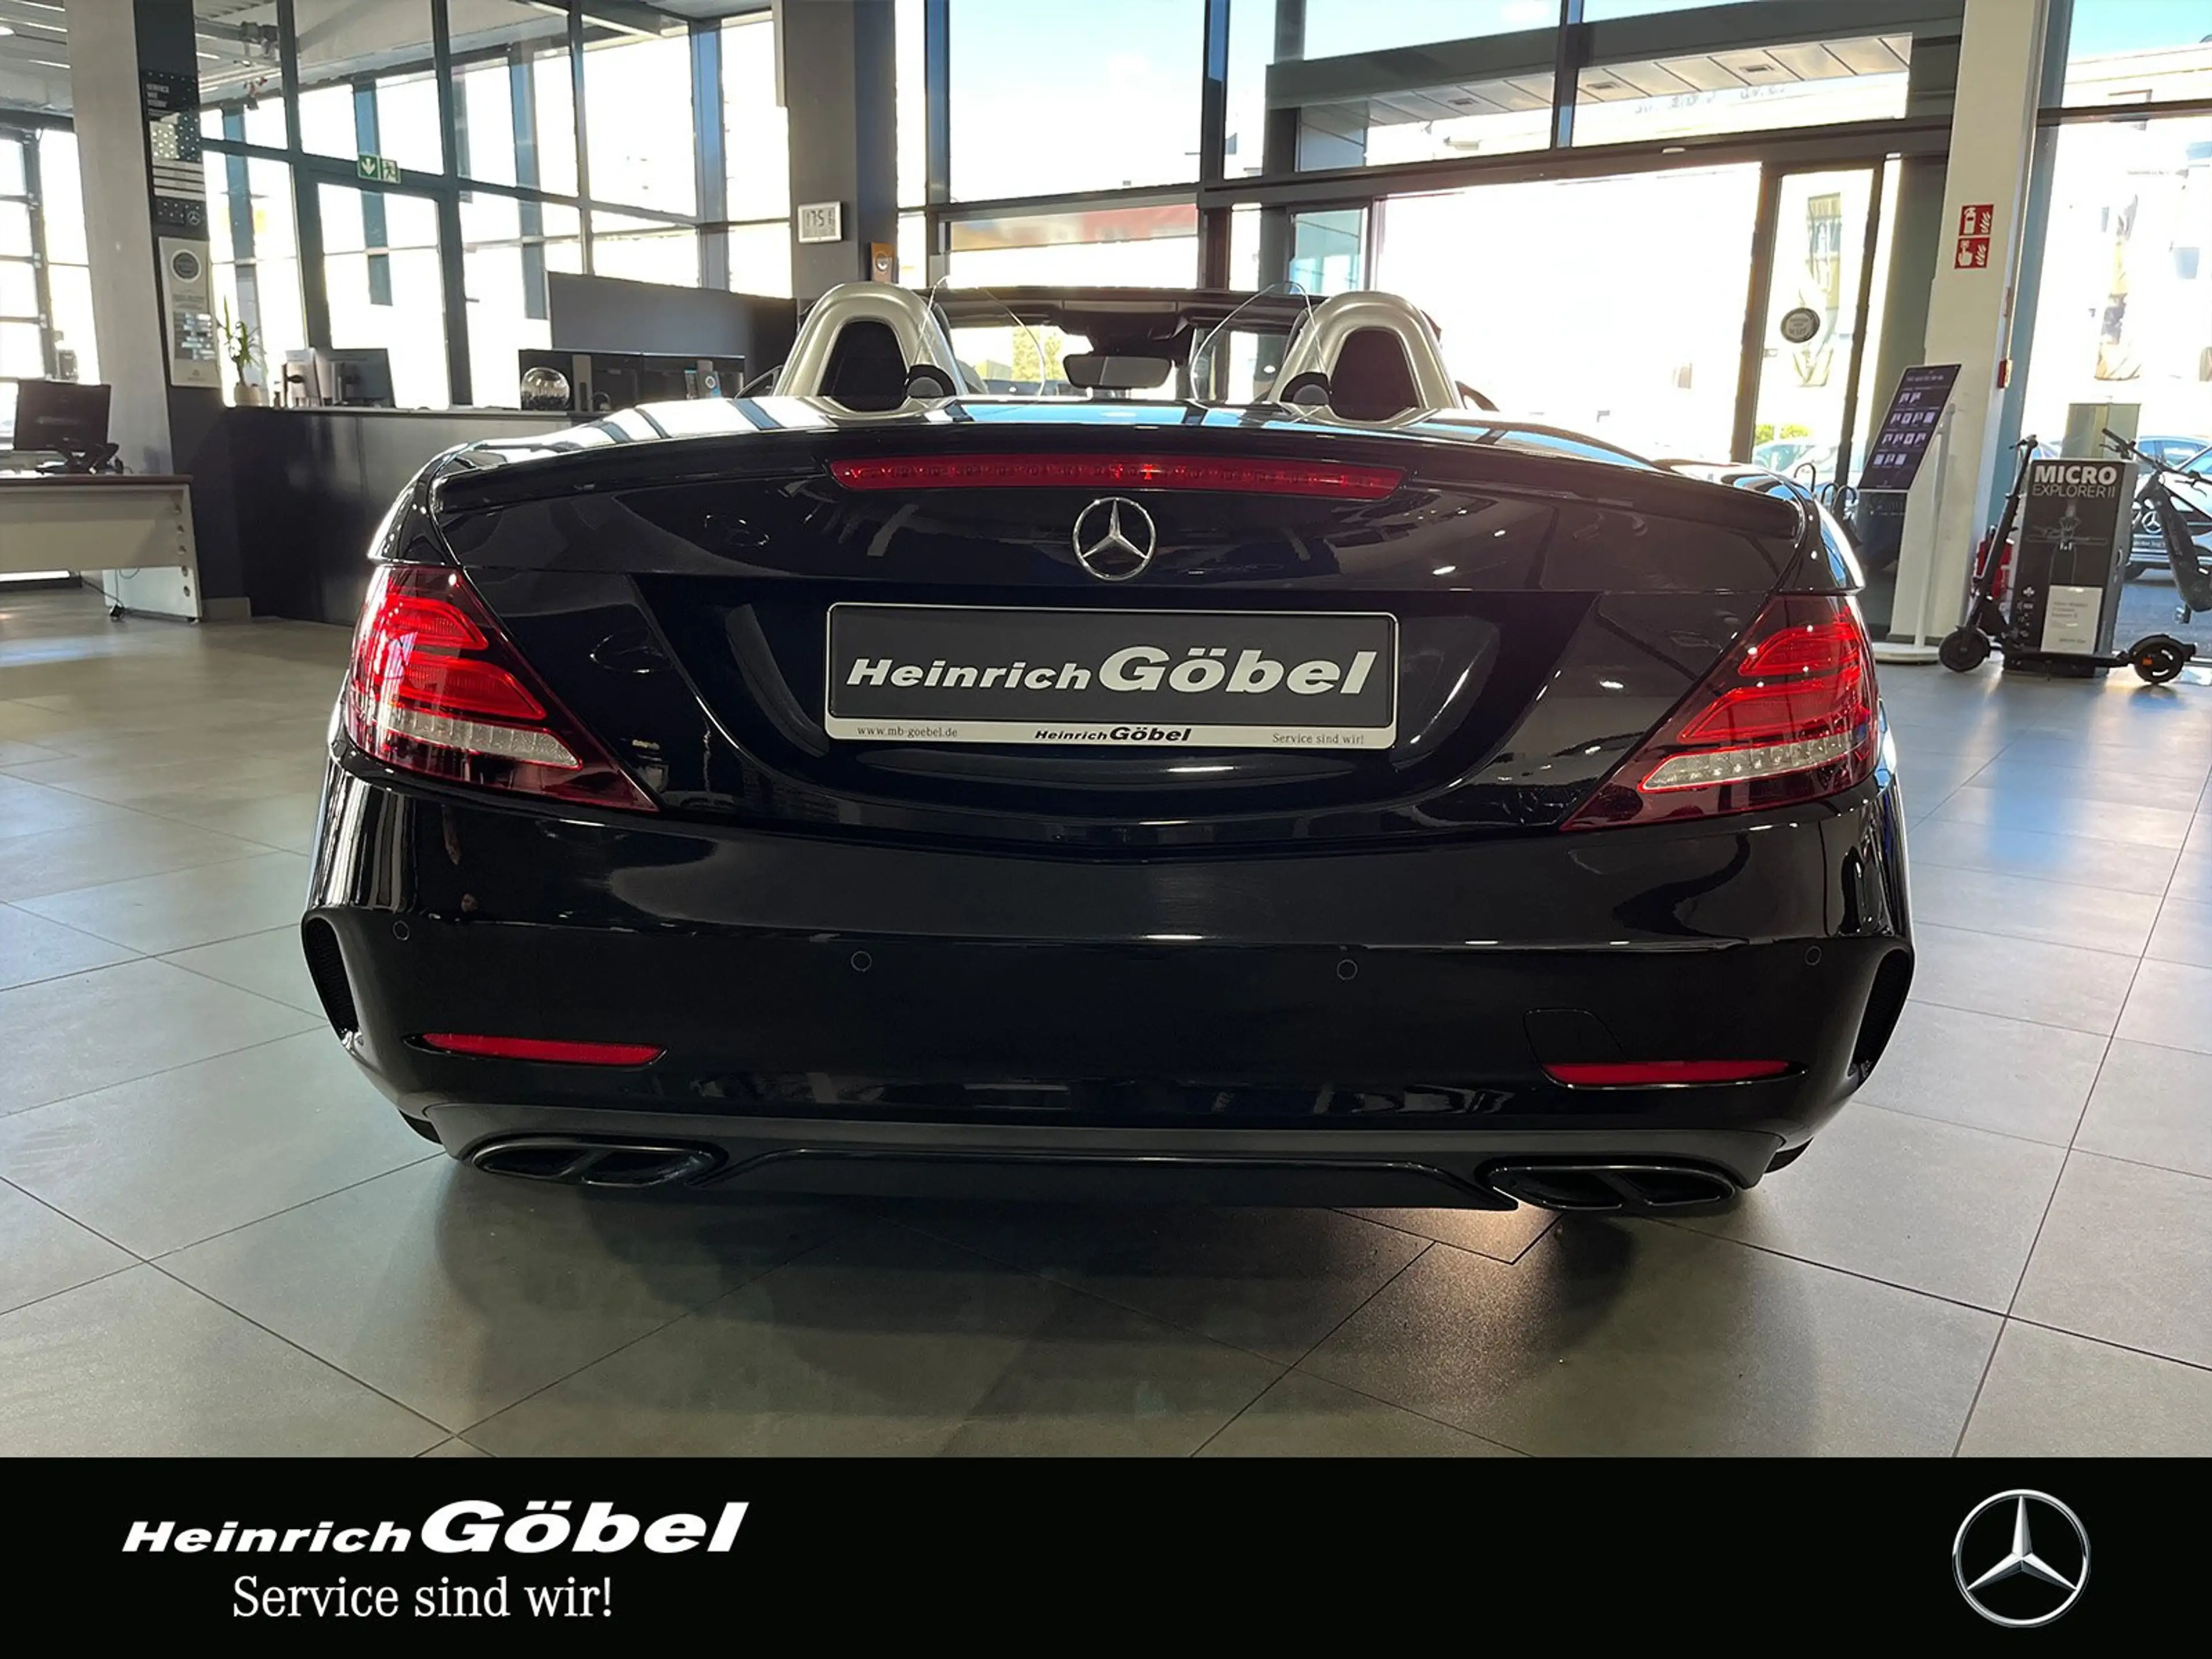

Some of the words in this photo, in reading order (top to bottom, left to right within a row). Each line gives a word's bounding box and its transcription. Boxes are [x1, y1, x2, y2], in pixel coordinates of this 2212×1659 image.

[2035, 465, 2117, 485] MICRO
[2032, 484, 2105, 498] EXPLORER
[846, 658, 1092, 690] Heinrich
[1099, 646, 1377, 694] Göbel
[857, 726, 957, 738] www.mb-goebel.de
[1035, 730, 1108, 740] Heinrich
[1109, 726, 1192, 741] Göbel
[1272, 732, 1313, 744] Service
[1316, 734, 1339, 744] sind
[1342, 734, 1364, 745] wir!
